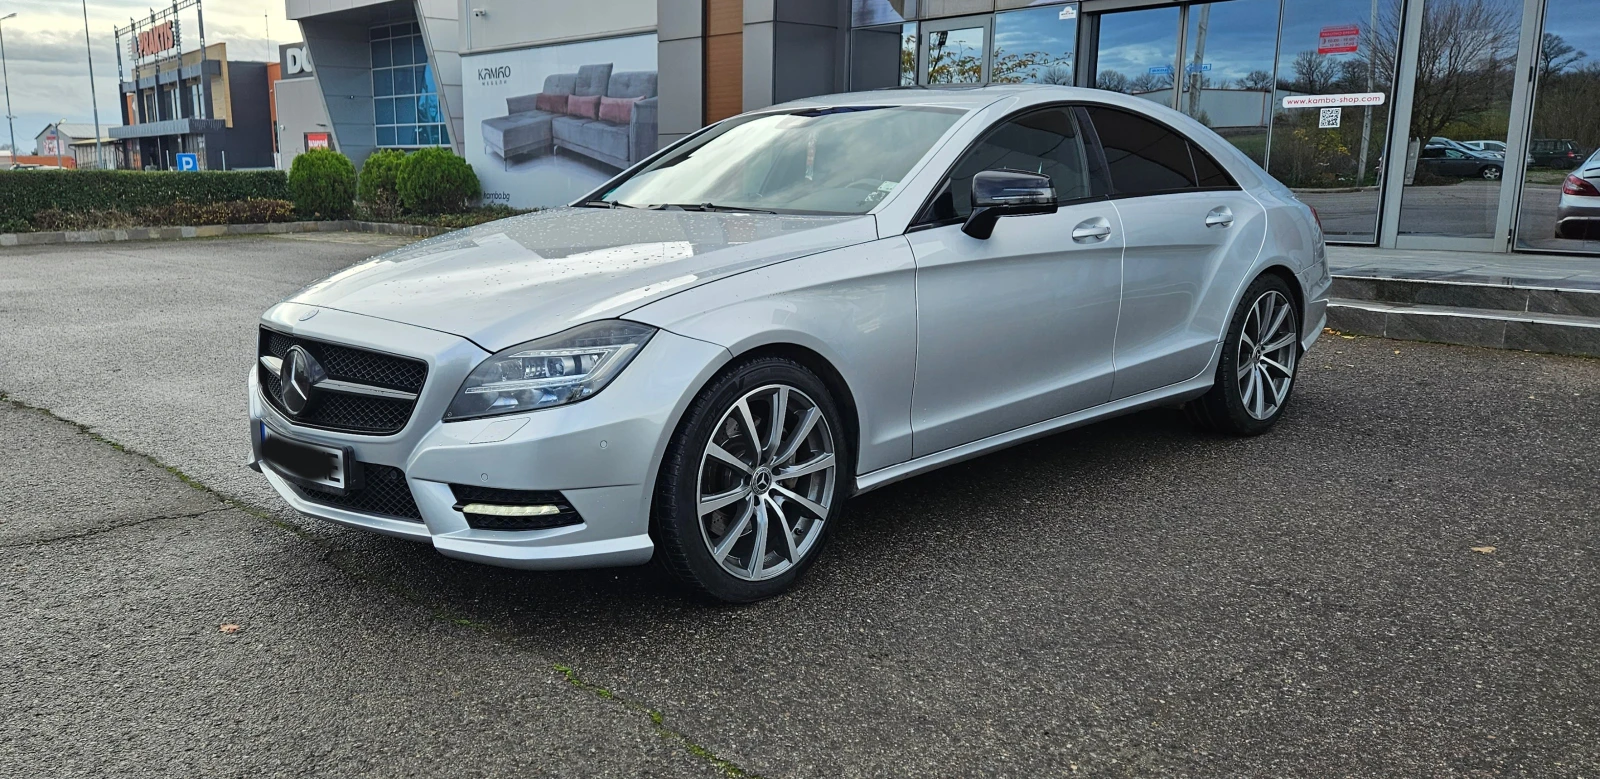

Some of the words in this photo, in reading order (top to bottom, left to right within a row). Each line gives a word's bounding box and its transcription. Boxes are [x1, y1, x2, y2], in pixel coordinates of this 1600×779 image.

[138, 20, 174, 57] PRAKTIS
[1287, 96, 1381, 105] www.kambo-shop.com
[183, 157, 194, 171] P
